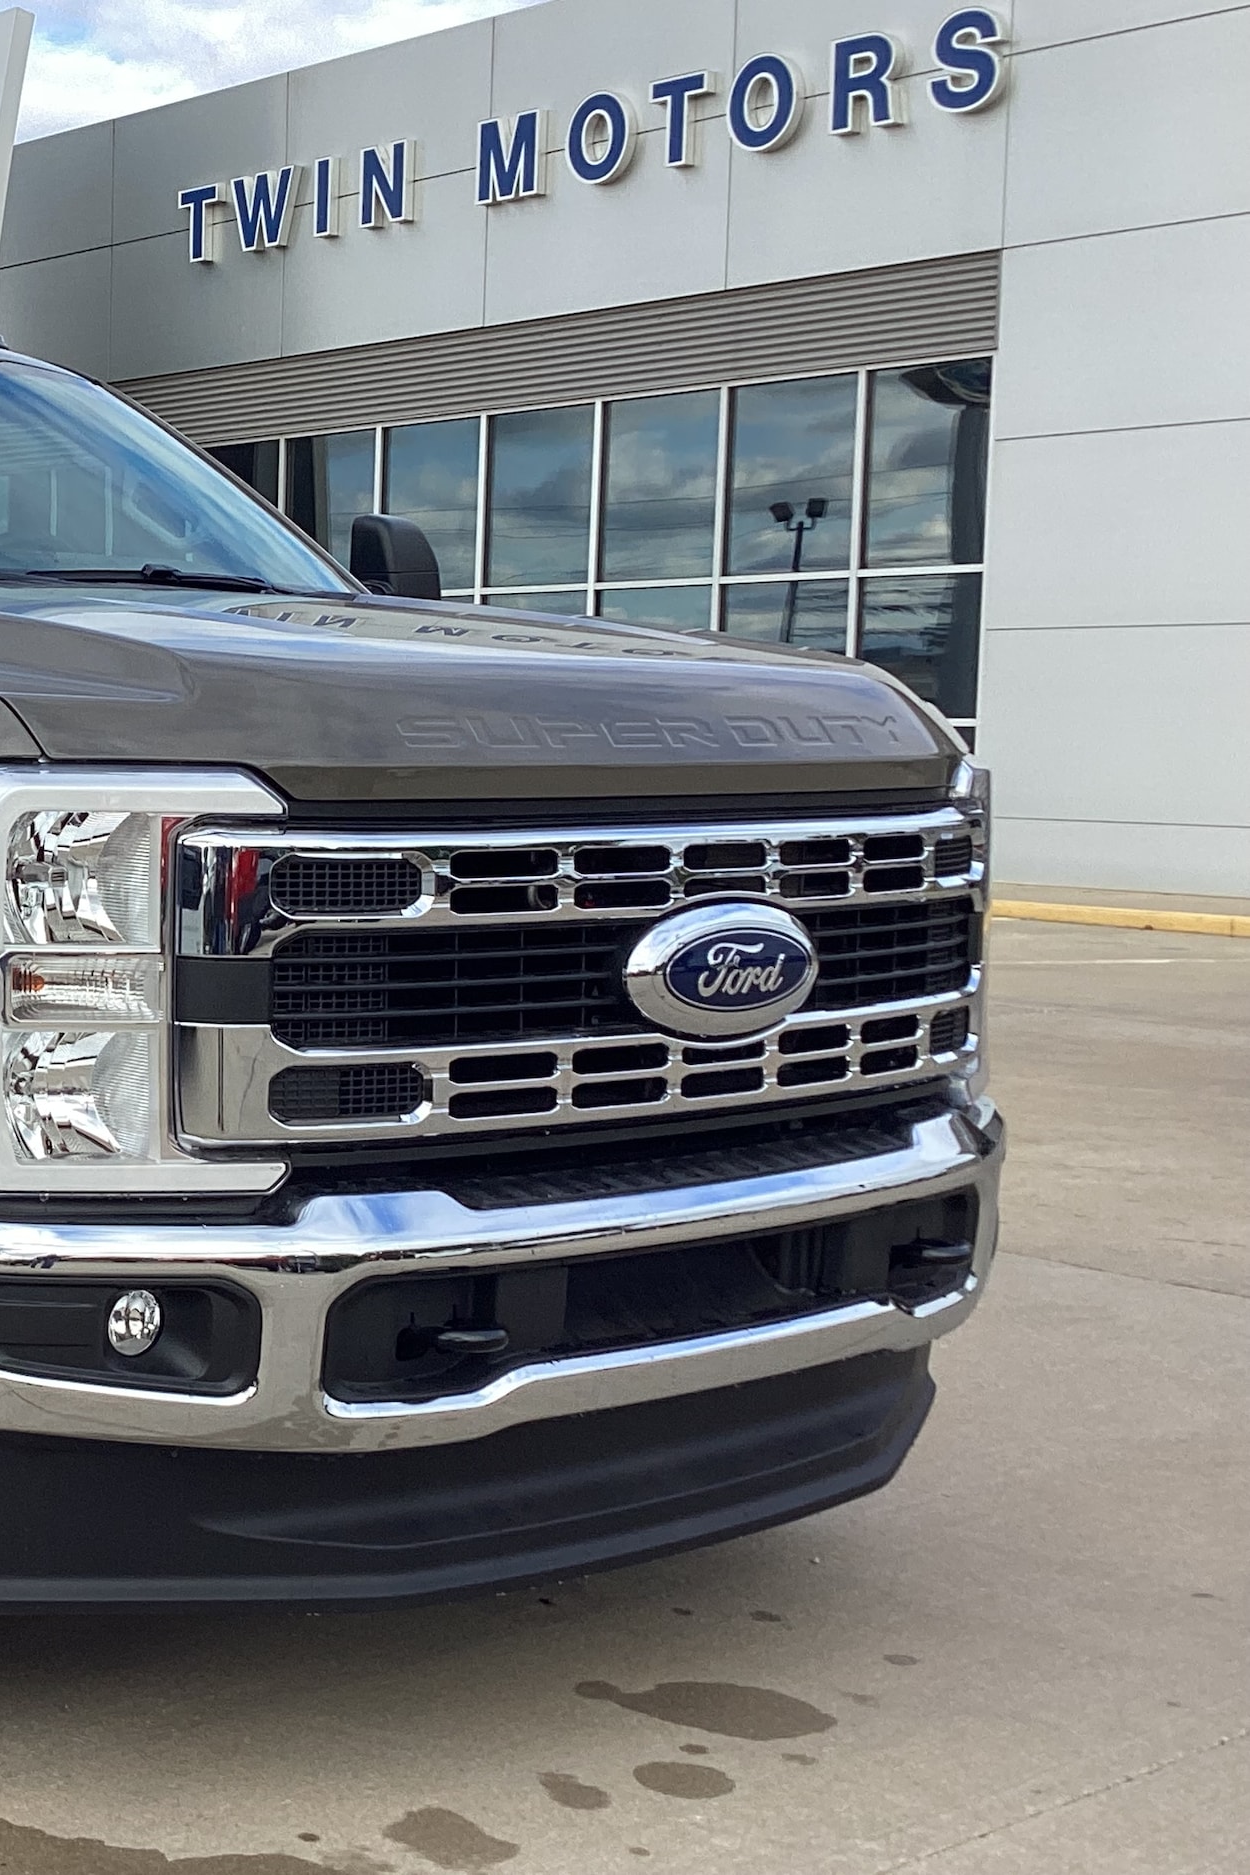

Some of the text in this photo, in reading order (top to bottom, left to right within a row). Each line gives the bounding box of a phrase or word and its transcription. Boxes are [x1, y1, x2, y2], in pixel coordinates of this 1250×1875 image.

[178, 6, 1006, 263] TWIN MOTORS
[396, 714, 901, 748] SUPER DUTY
[698, 942, 786, 997] Ford
